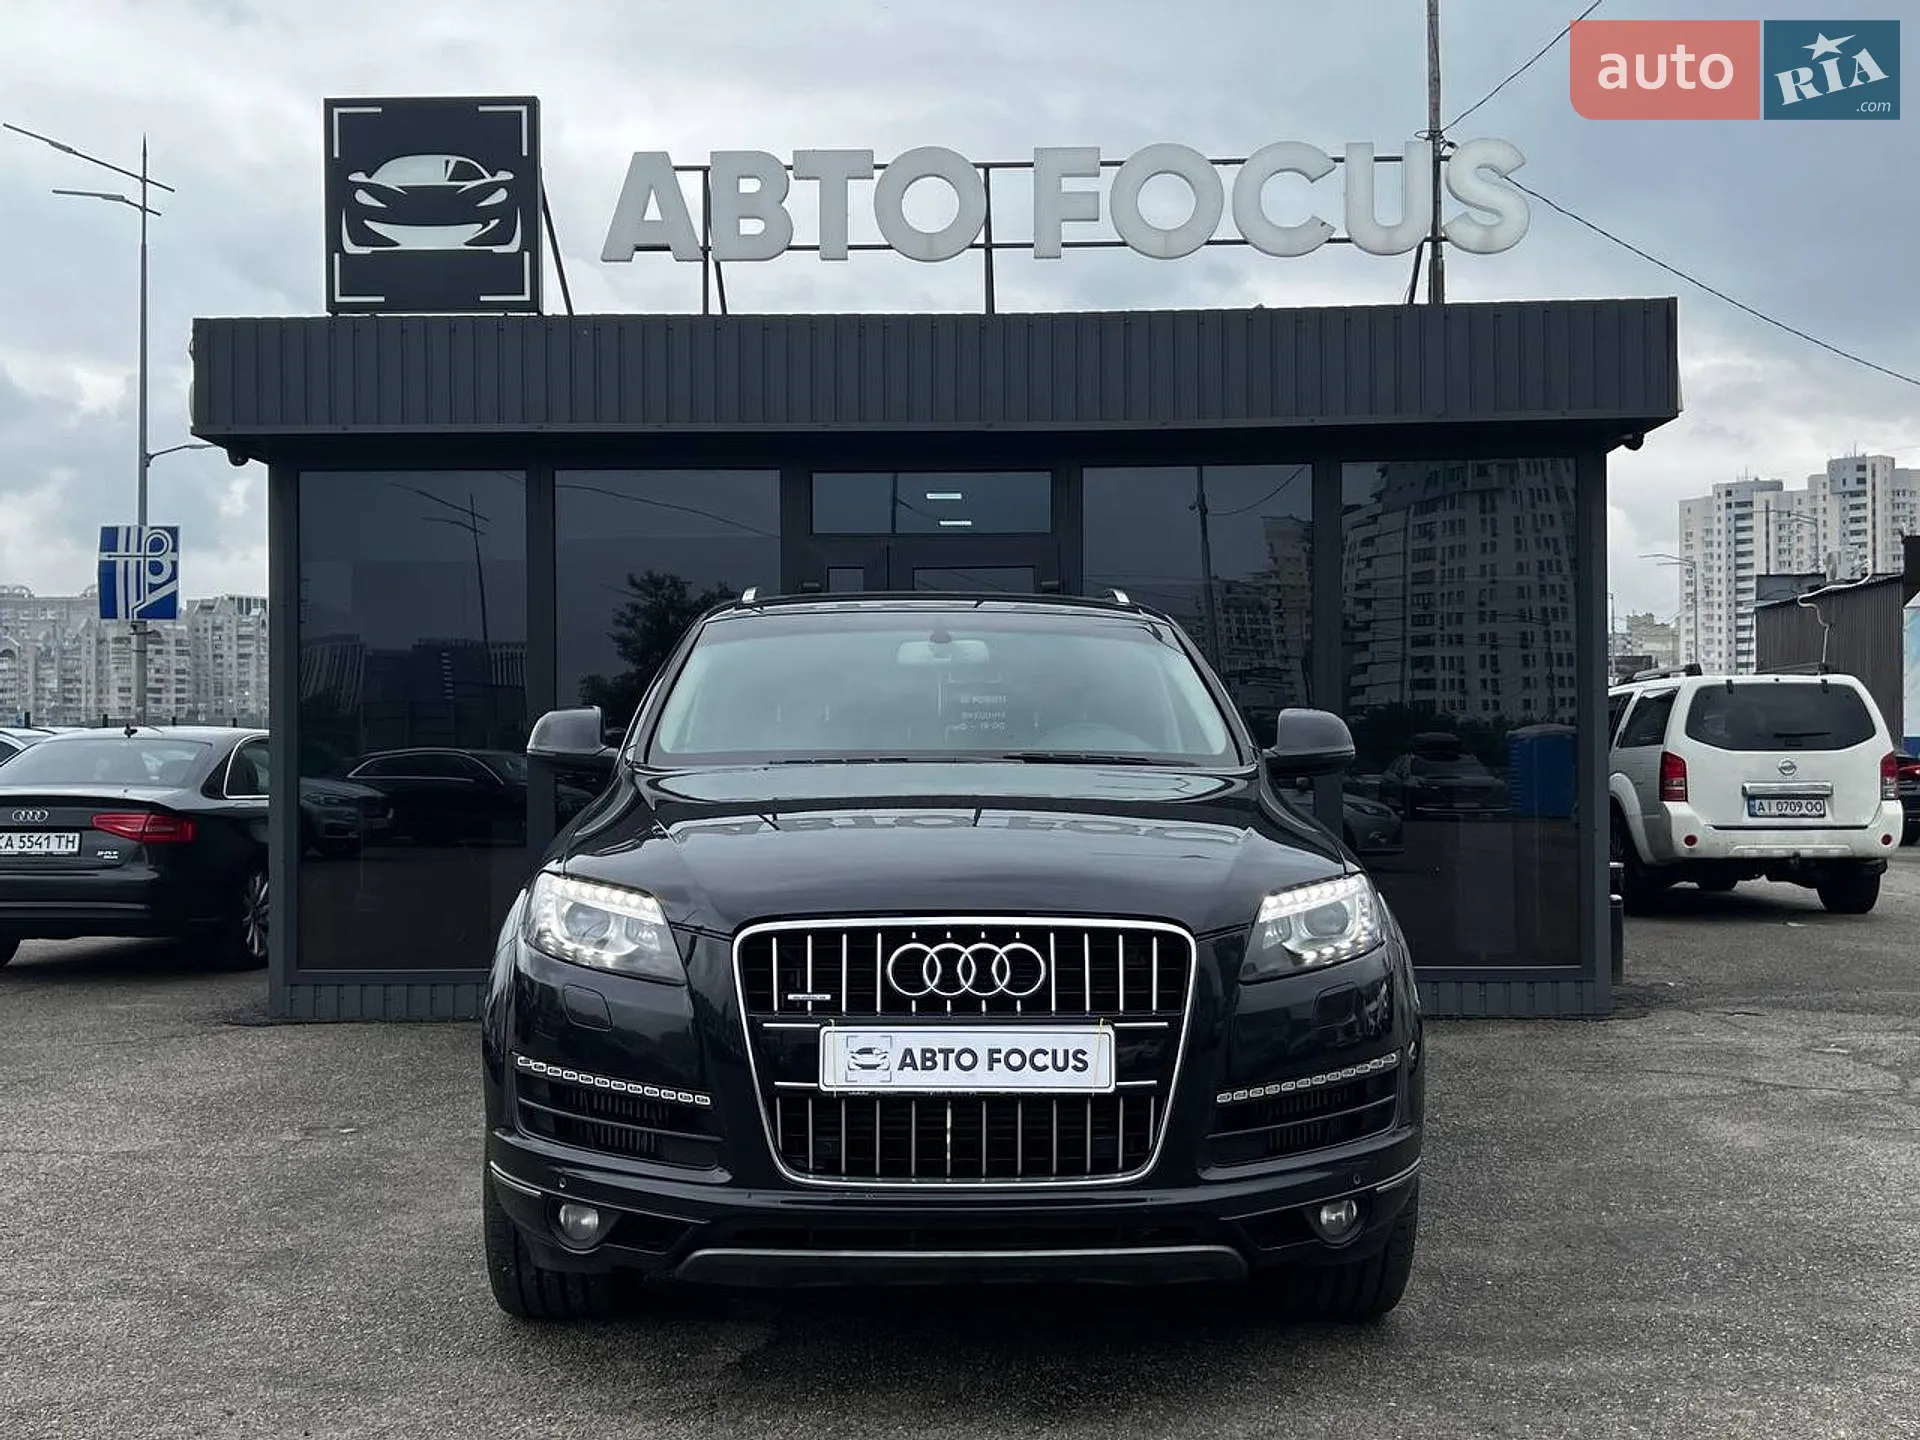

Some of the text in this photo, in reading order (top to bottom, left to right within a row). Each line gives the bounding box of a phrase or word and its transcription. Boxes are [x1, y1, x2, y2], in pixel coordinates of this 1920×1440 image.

[601, 137, 1531, 262] АВТО FOCUS
[1758, 801, 1772, 812] AI
[1776, 801, 1803, 812] 0709
[18, 835, 51, 849] 5541
[54, 835, 77, 849] TH
[898, 1048, 1089, 1072] АВТО FOCUS
